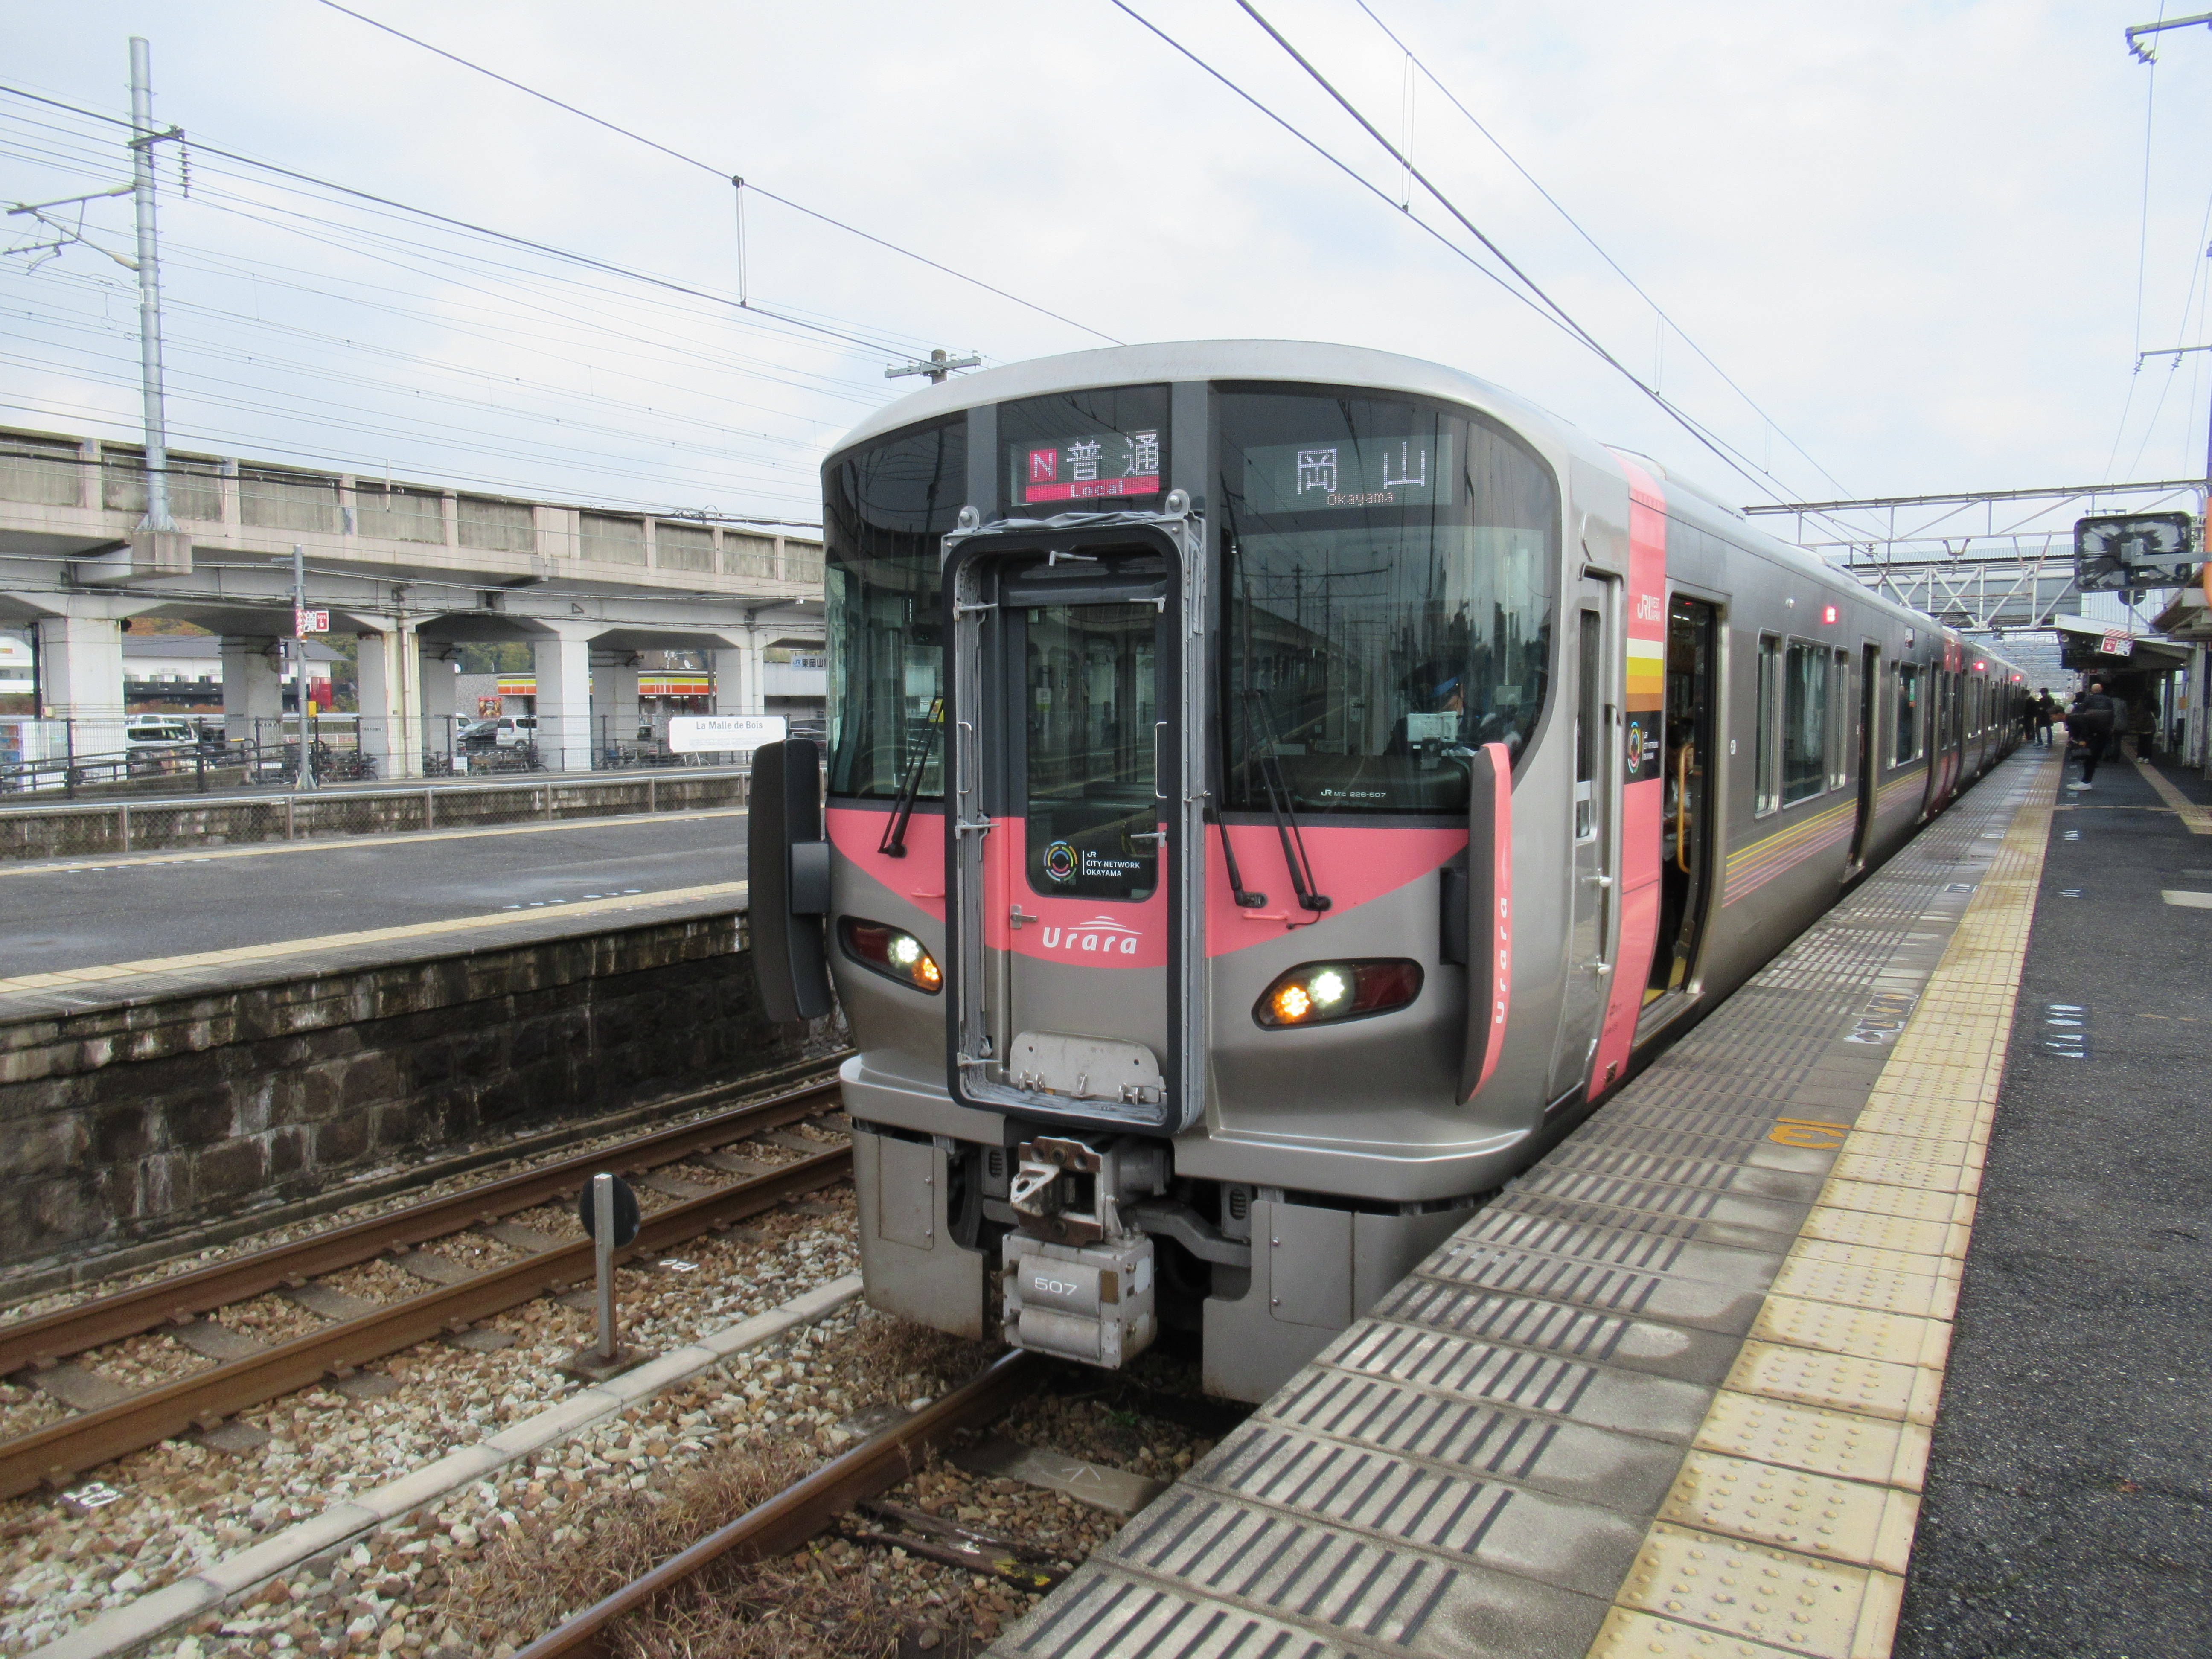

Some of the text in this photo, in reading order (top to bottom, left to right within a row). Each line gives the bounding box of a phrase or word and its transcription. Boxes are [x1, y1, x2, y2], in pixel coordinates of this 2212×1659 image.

[1066, 429, 1159, 481] 普通
[1033, 453, 1054, 478] N
[1297, 441, 1426, 495] 岡山
[1070, 480, 1124, 498] Local
[1327, 492, 1394, 506] Okayama
[802, 658, 826, 668] 東岡山
[696, 721, 763, 730] La Malle de Bois
[1321, 789, 1332, 797] JR
[1086, 869, 1122, 877] OKAYAMA
[1104, 861, 1140, 869] NETWORK
[1043, 927, 1137, 954] Urara
[1496, 897, 1507, 1023] Urara
[1035, 1277, 1077, 1295] 507
